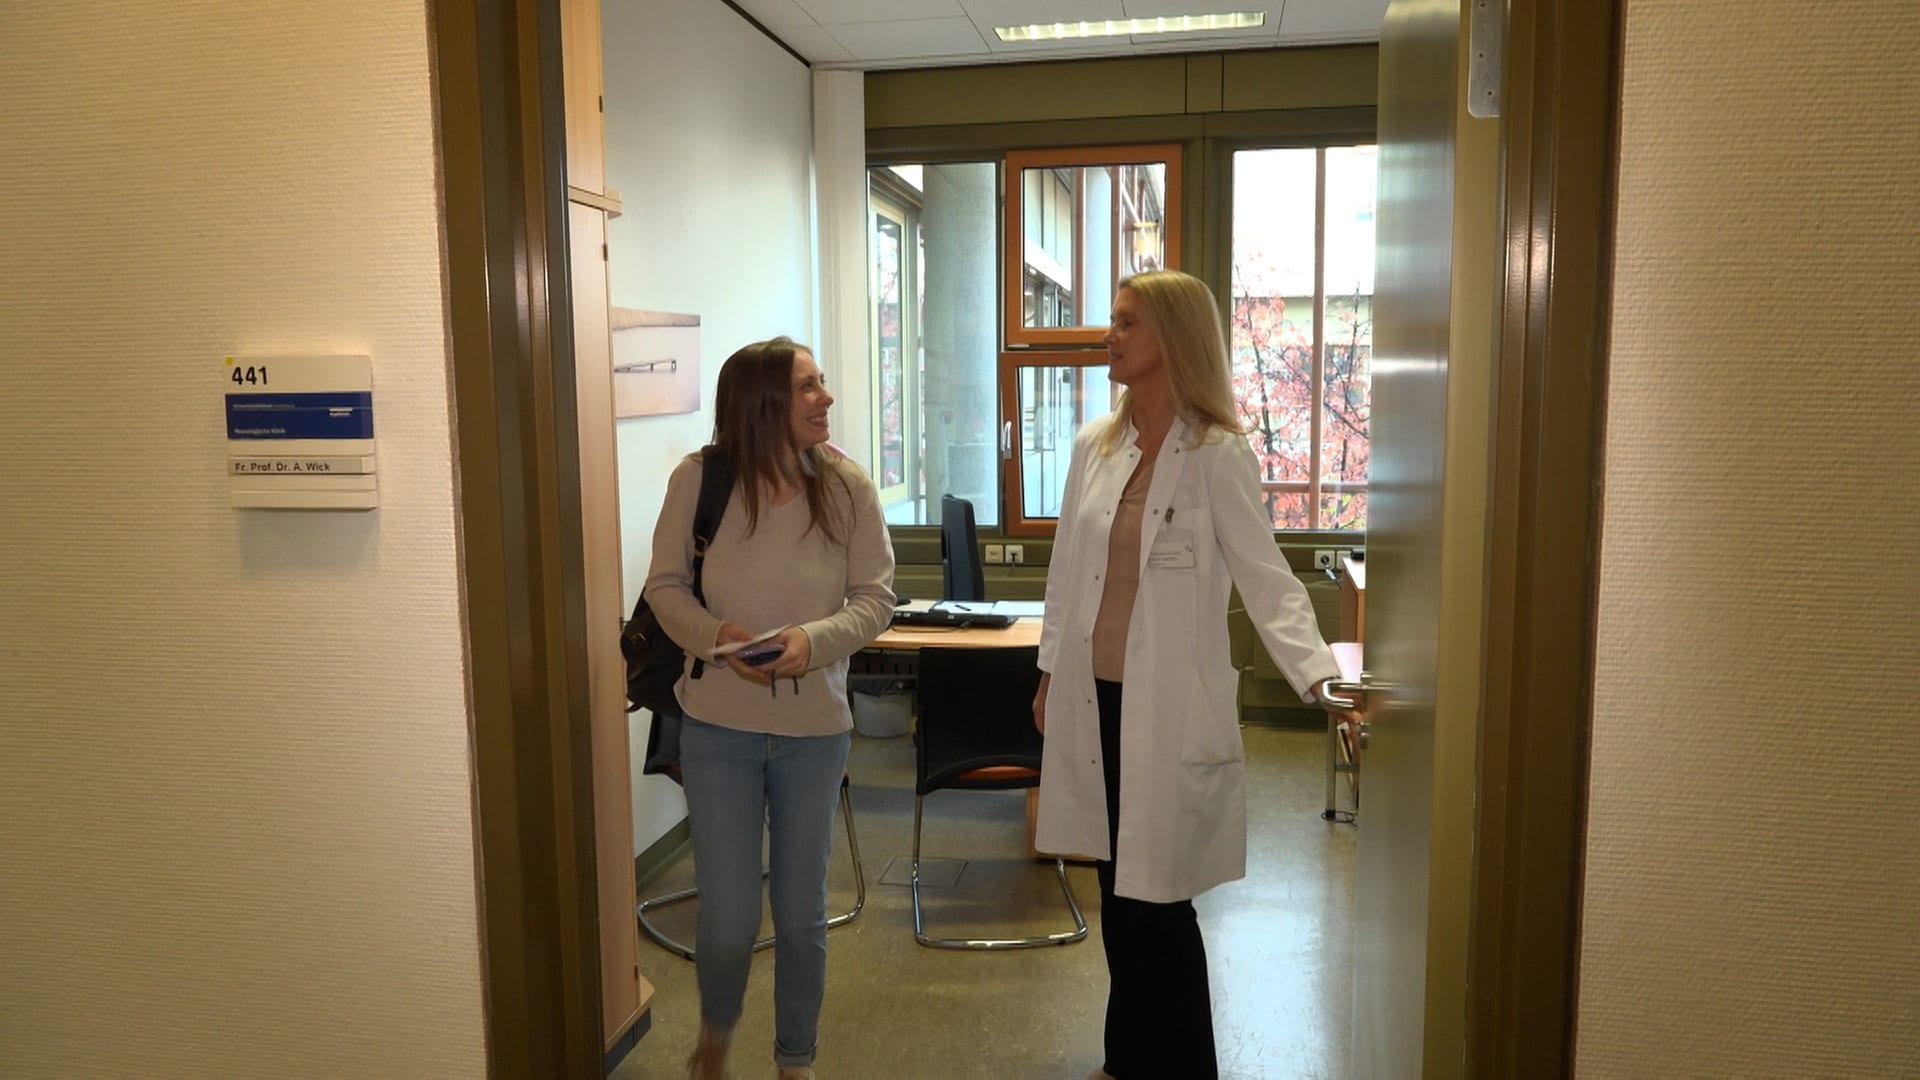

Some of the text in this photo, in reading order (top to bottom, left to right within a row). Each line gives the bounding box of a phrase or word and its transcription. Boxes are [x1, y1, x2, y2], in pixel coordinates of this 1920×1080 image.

[232, 366, 267, 385] 441
[234, 462, 330, 471] Fr. Prof. Dr. A. Wick
